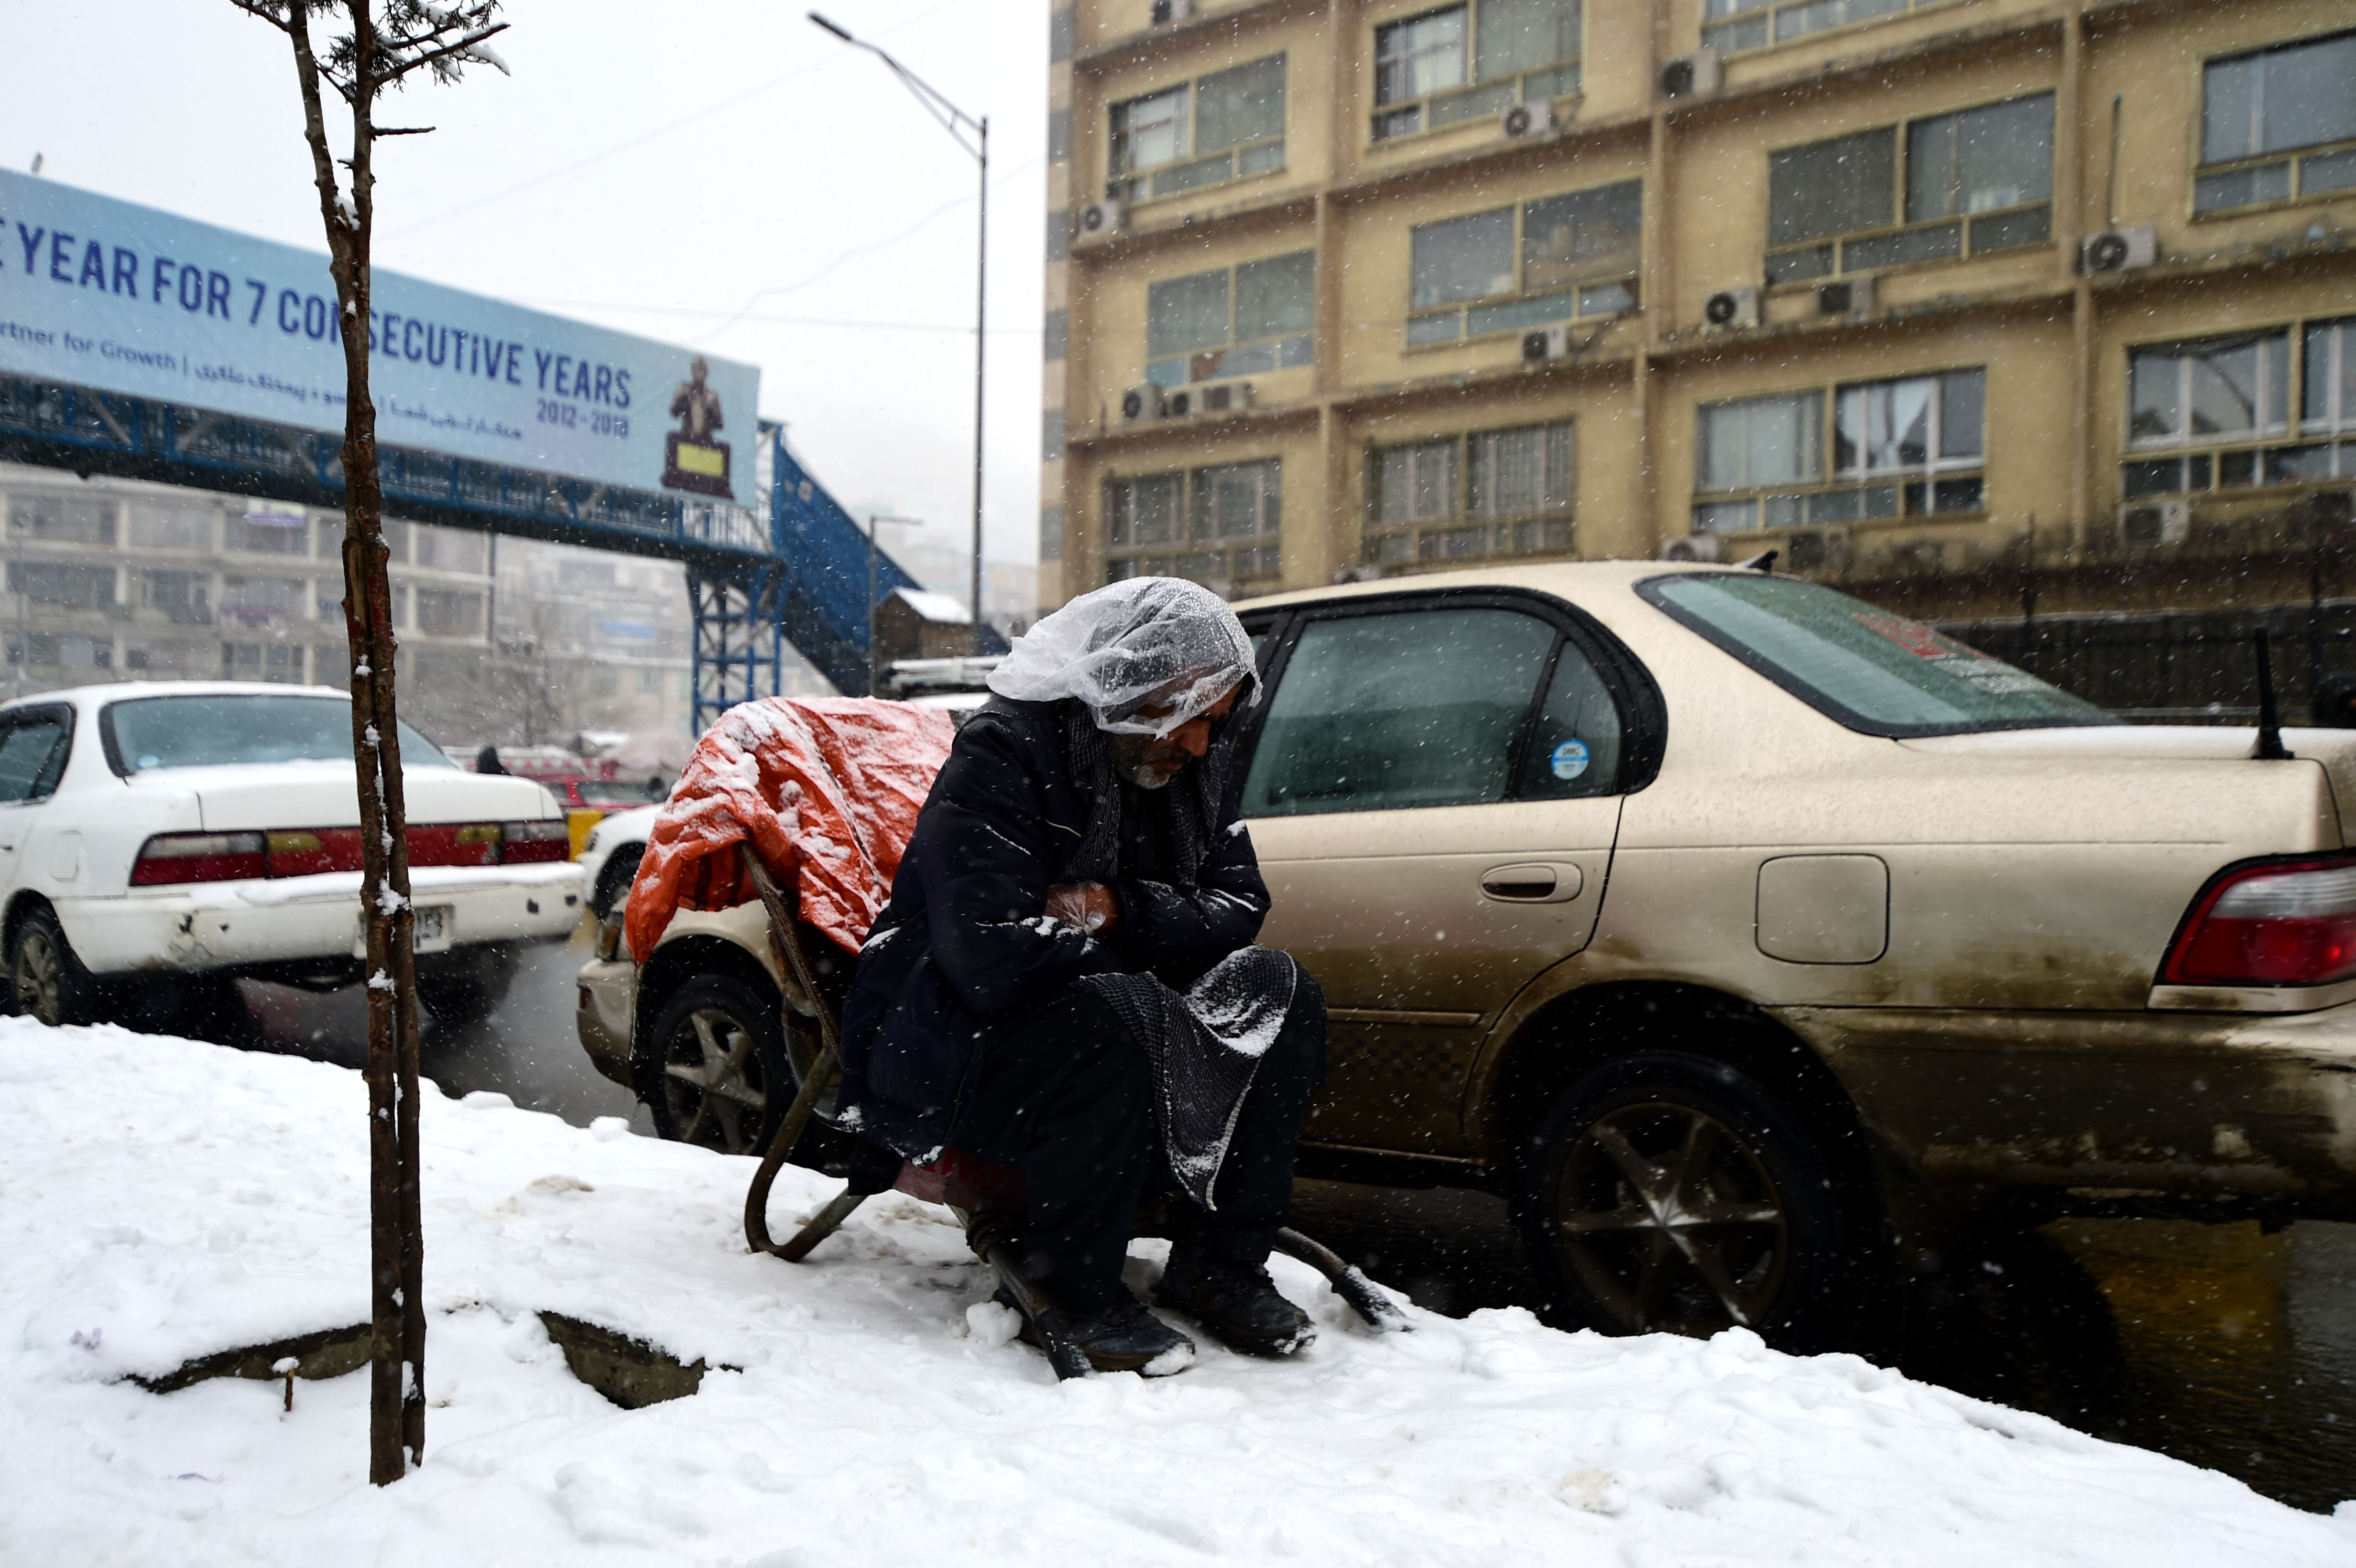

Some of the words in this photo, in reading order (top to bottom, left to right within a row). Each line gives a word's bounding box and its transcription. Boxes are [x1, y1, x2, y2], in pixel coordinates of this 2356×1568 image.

[17, 220, 137, 297] YEAR
[154, 257, 230, 319] FOR
[245, 277, 266, 325] 7
[534, 348, 630, 407] YEARS
[64, 330, 94, 354] for
[100, 339, 176, 370] Growth
